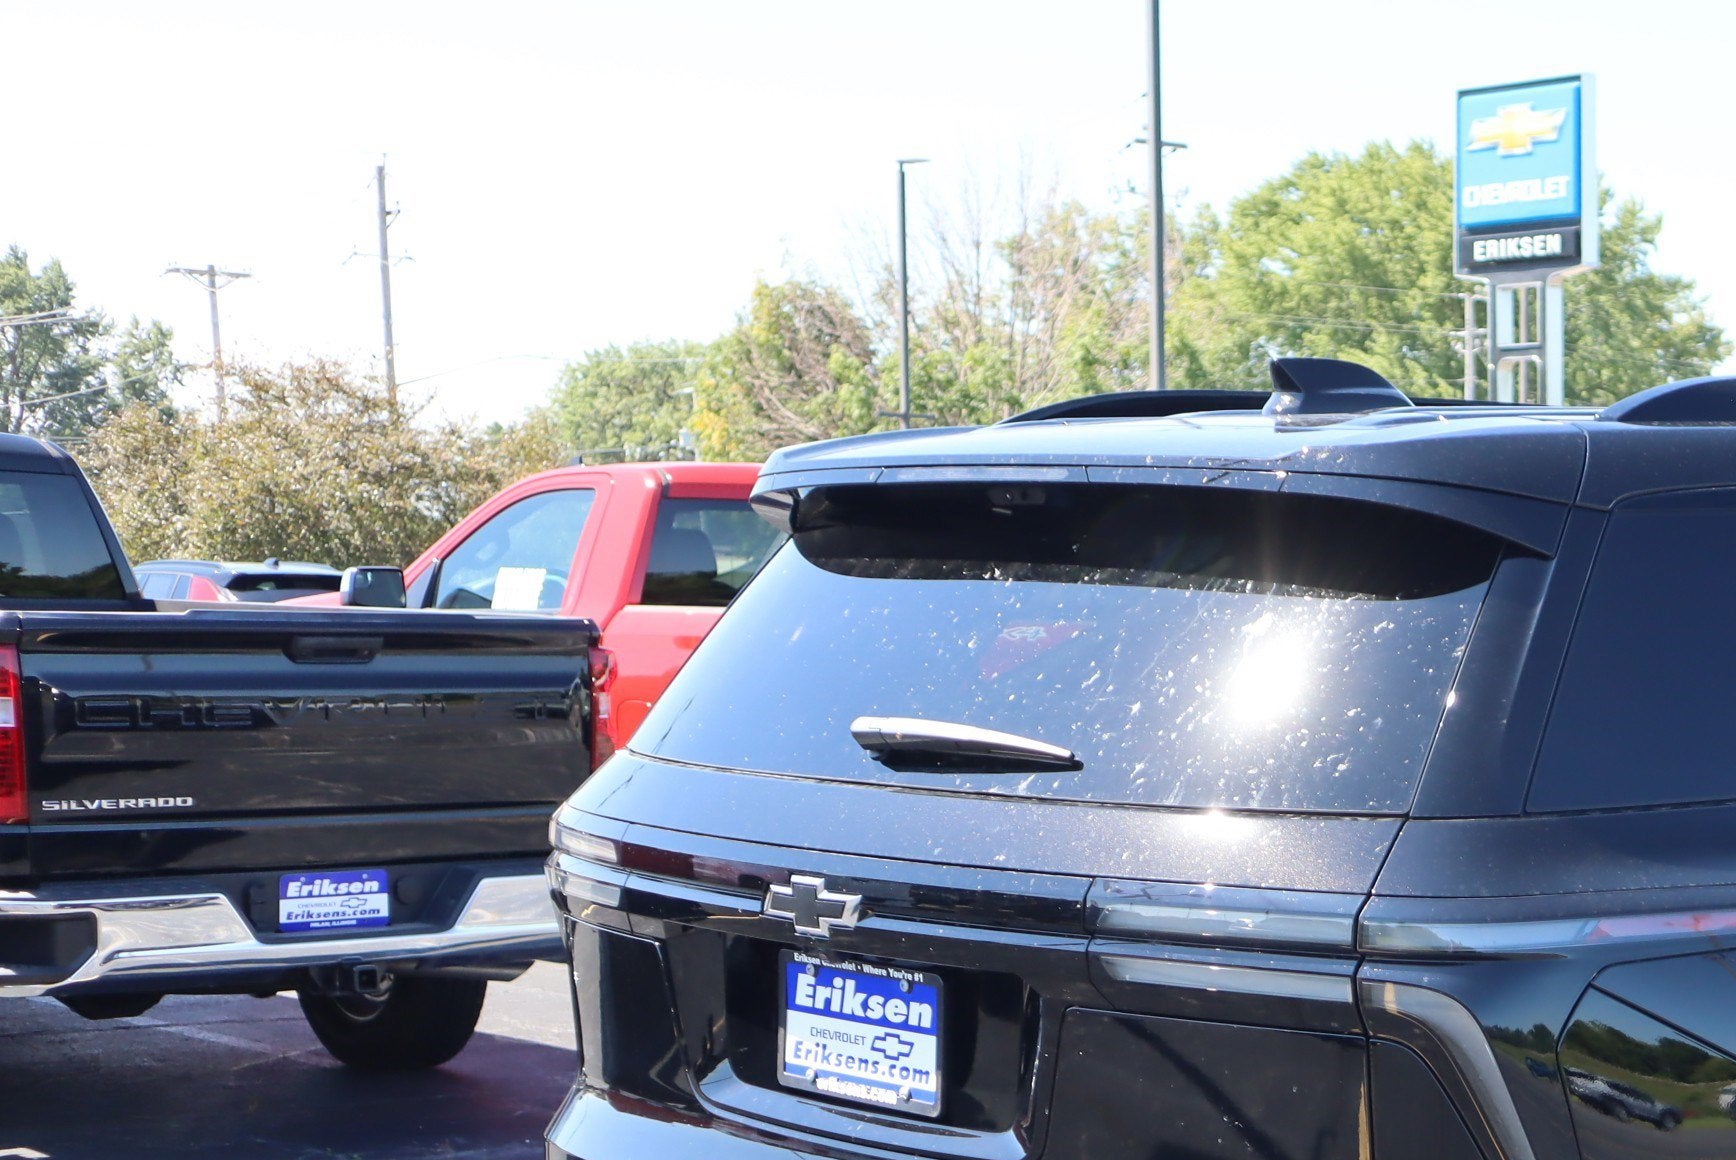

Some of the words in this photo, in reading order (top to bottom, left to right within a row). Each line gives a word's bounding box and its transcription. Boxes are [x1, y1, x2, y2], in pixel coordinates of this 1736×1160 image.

[1463, 175, 1569, 208] CHEVROLET
[1473, 234, 1562, 262] ERIKSEN
[42, 796, 193, 811] SILVERADO
[287, 879, 379, 898] Eriksen
[286, 908, 380, 921] Eriksens.com
[794, 952, 820, 965] Eriksen
[862, 963, 886, 976] Where
[795, 973, 932, 1028] Eriksen
[810, 1026, 866, 1046] CHEVROLET
[793, 1041, 930, 1084] Eriksens.com
